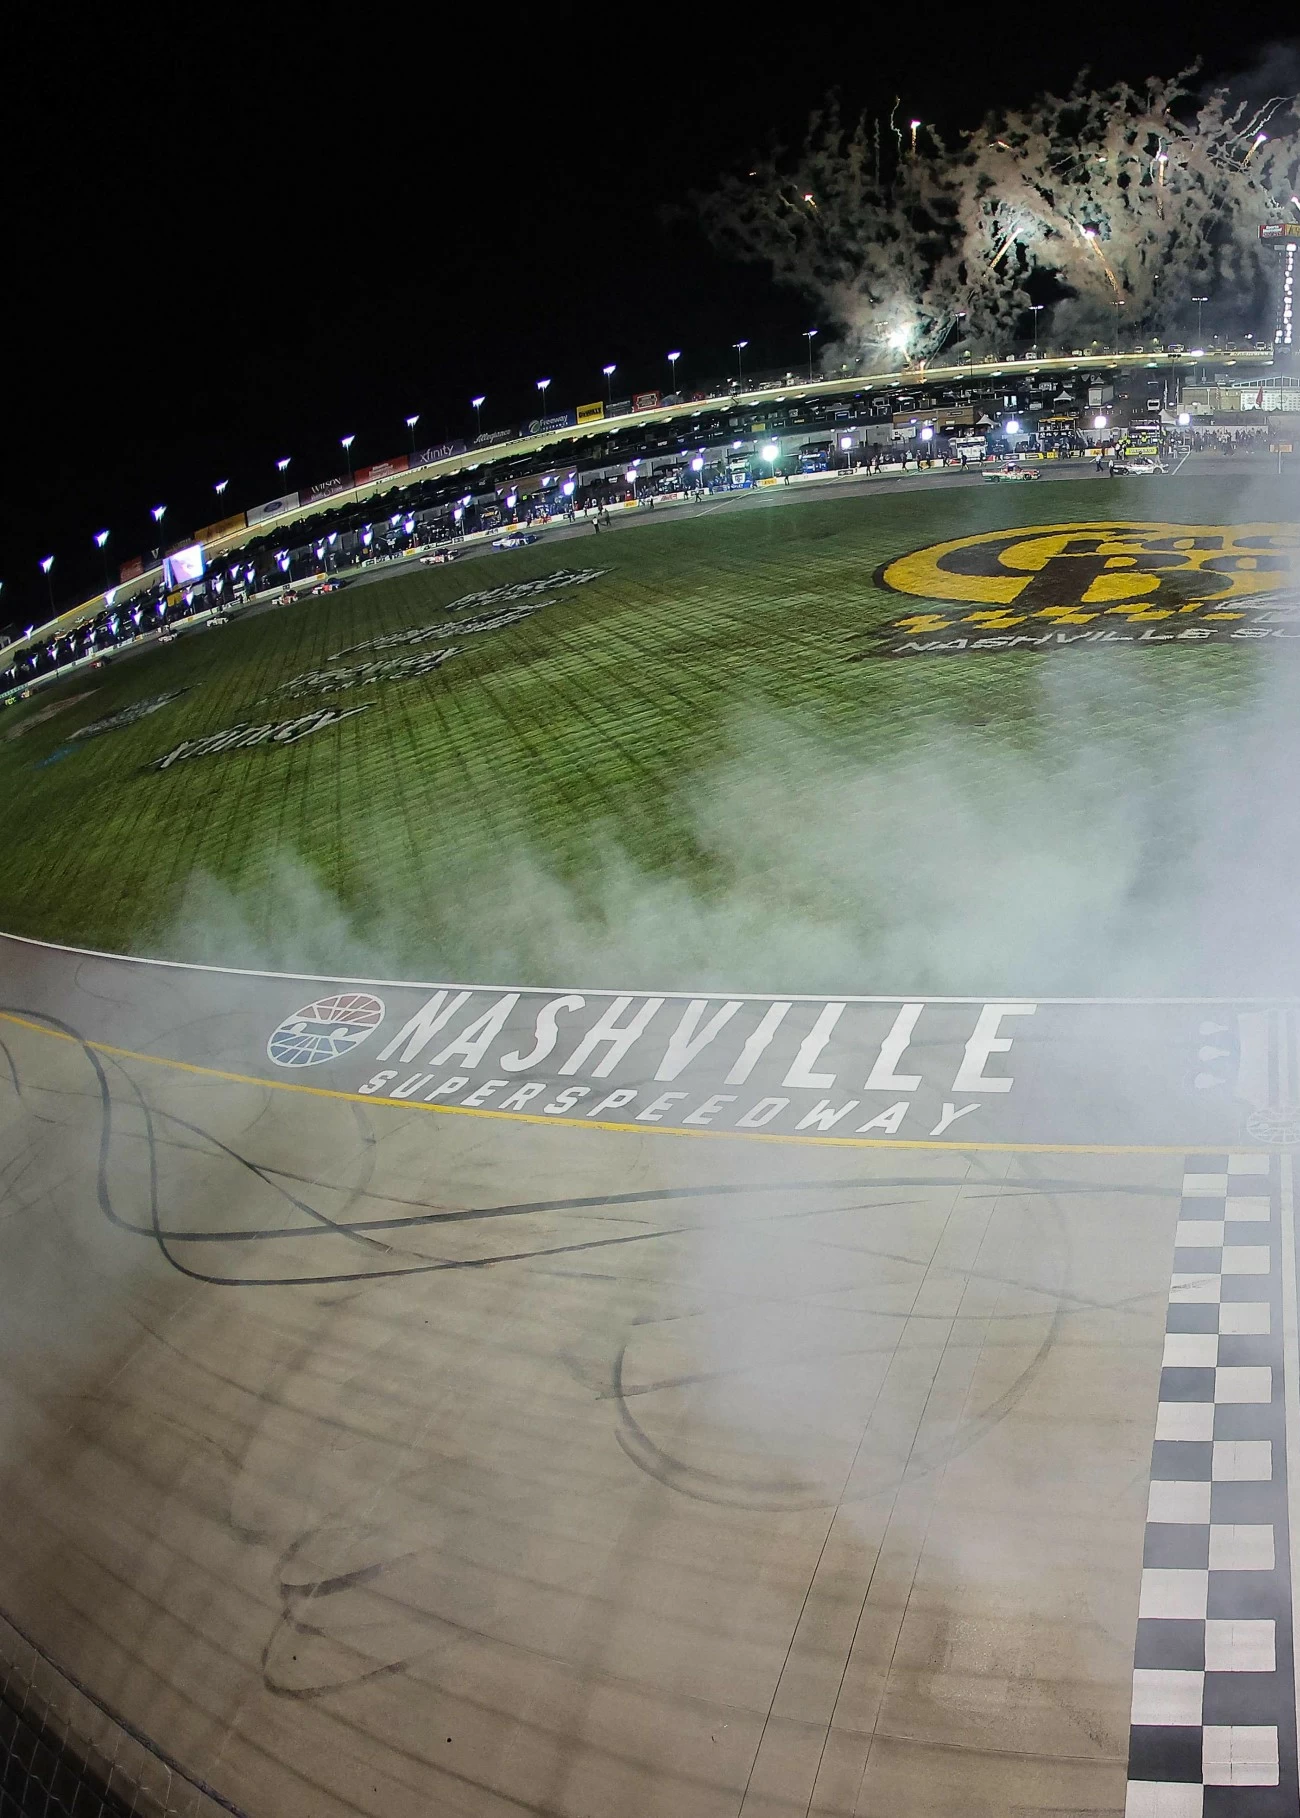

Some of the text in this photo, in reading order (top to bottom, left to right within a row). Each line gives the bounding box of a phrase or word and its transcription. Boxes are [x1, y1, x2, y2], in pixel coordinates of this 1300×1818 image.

[540, 413, 568, 428] Freeway
[419, 444, 454, 463] xfinity
[891, 628, 1219, 652] NASHVILLE
[376, 990, 1038, 1093] NASHVILLE
[358, 1070, 982, 1136] SUPERSPEEDWAY
